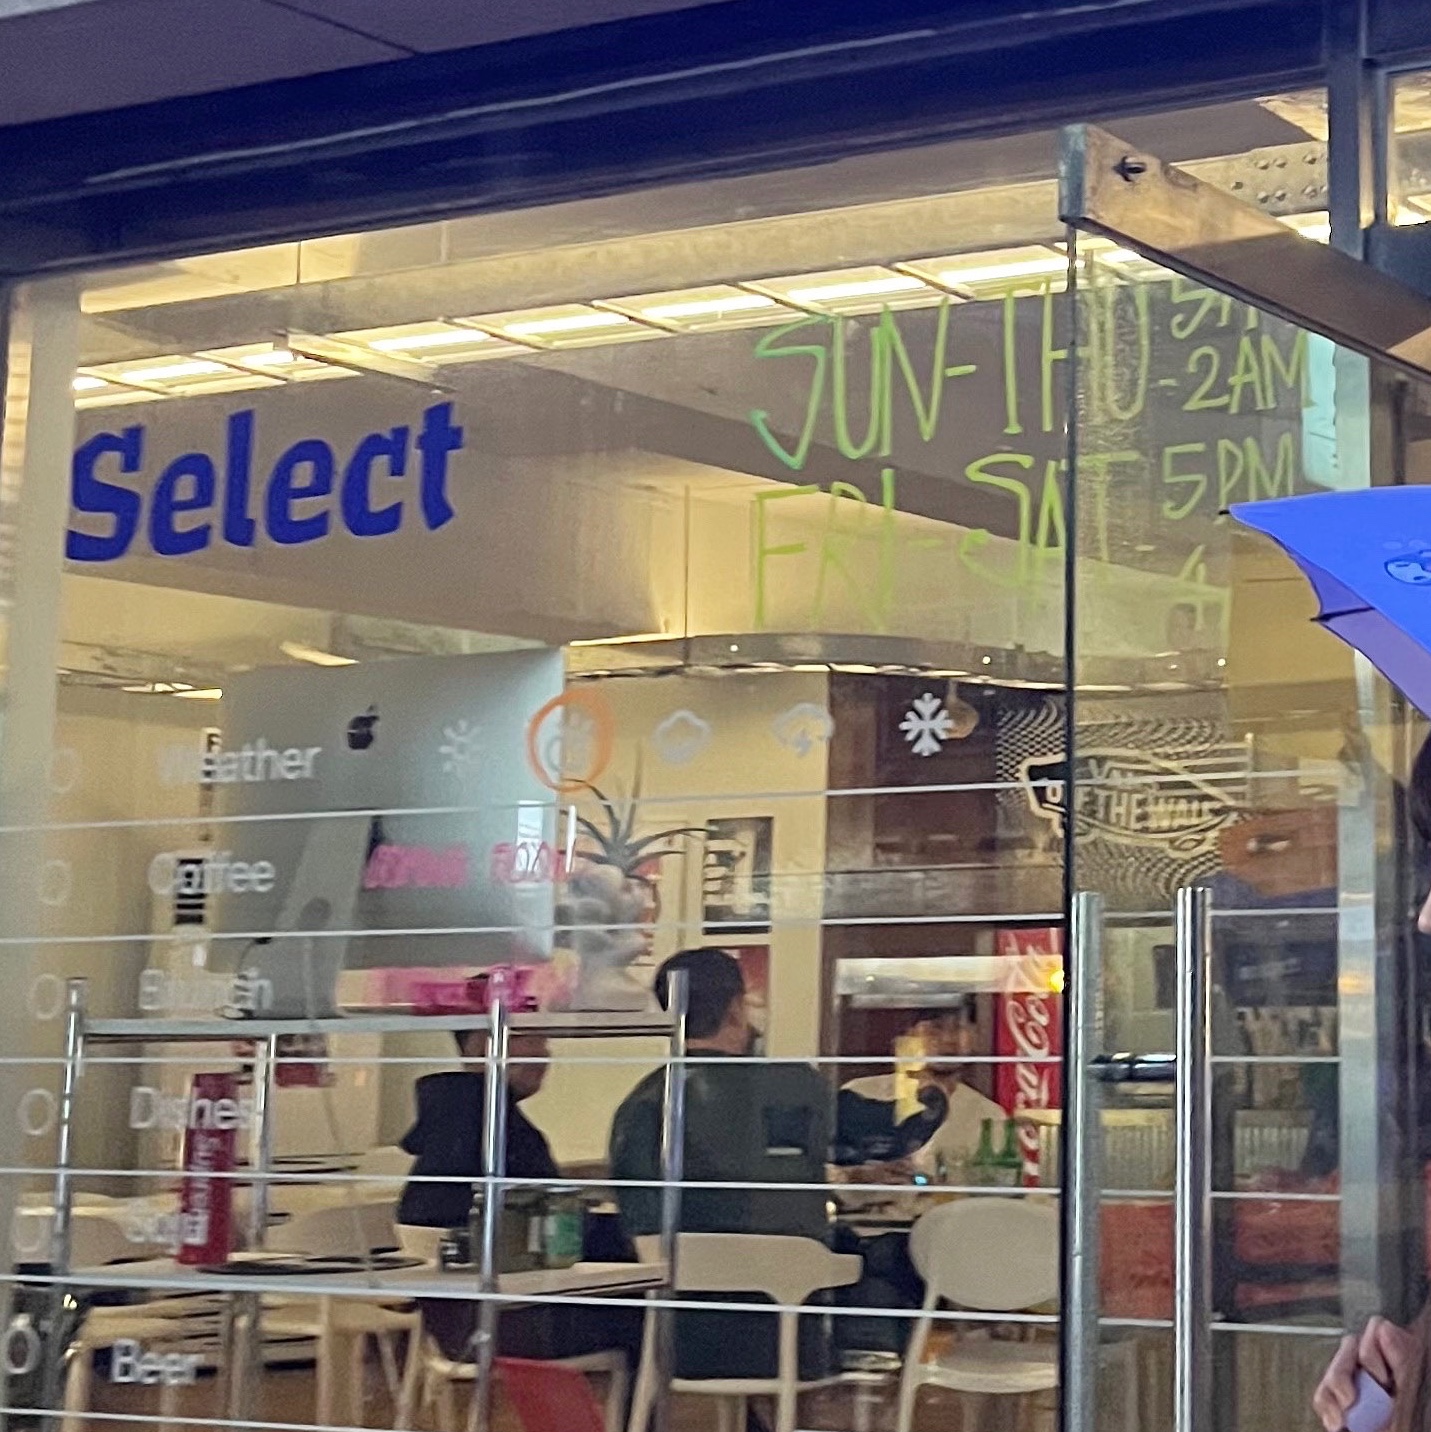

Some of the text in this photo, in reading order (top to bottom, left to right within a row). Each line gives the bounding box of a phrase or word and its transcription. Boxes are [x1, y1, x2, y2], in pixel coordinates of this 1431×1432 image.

[65, 402, 464, 562] Select
[1163, 432, 1294, 525] 5PM
[149, 851, 276, 894] Coffee
[111, 1338, 205, 1385] Beer
